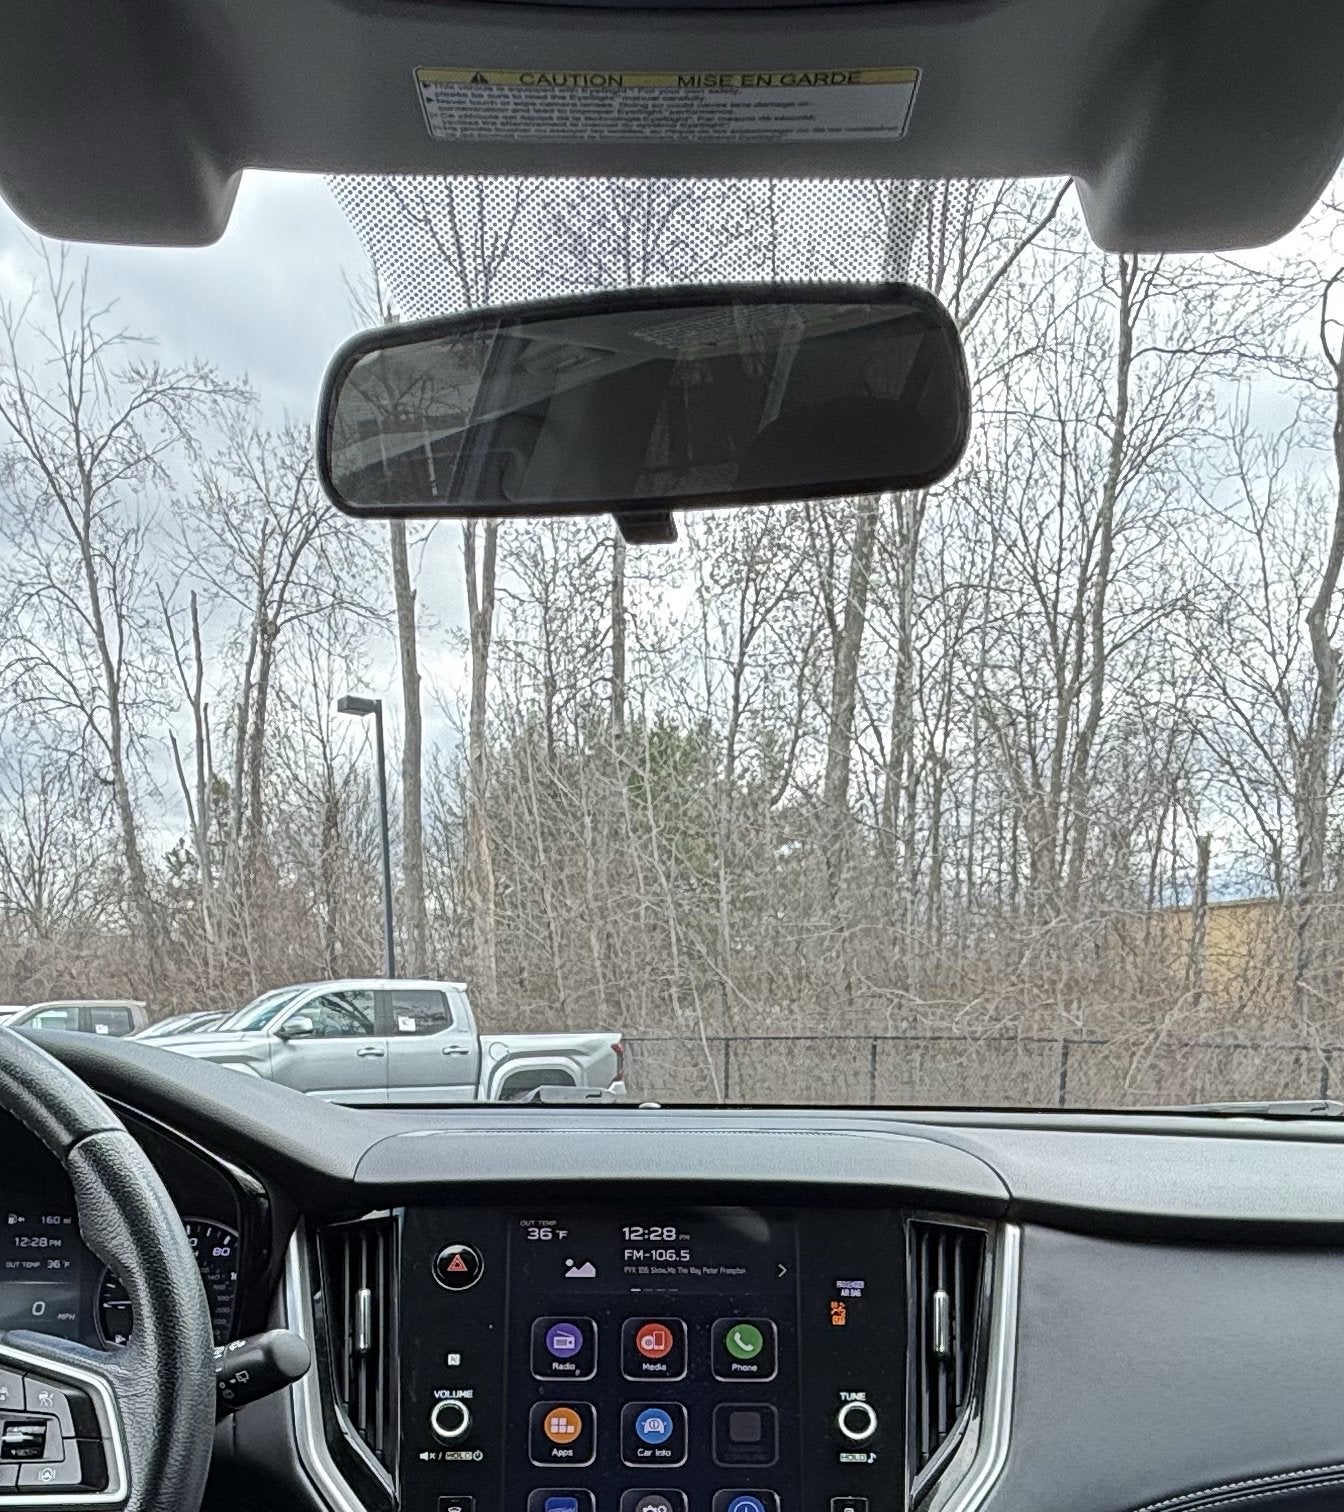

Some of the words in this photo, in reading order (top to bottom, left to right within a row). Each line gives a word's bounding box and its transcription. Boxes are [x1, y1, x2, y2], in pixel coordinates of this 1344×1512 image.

[519, 73, 623, 87] CAUTION
[677, 74, 735, 87] MISE
[741, 74, 772, 87] EN
[780, 71, 862, 86] GARDE
[41, 1216, 61, 1224] 160
[527, 1228, 553, 1240] 36
[622, 1227, 677, 1241] 12:28
[15, 1237, 48, 1247] 12:28
[213, 1247, 230, 1256] 80
[624, 1250, 690, 1261] FM-106.5
[32, 1301, 46, 1316] 0
[552, 1362, 576, 1370] Radio
[642, 1363, 667, 1371] Media
[731, 1363, 758, 1372] Phone
[434, 1390, 474, 1398] VOLUME
[839, 1392, 866, 1400] TUNE
[551, 1448, 574, 1457] Apps
[637, 1448, 653, 1457] Car
